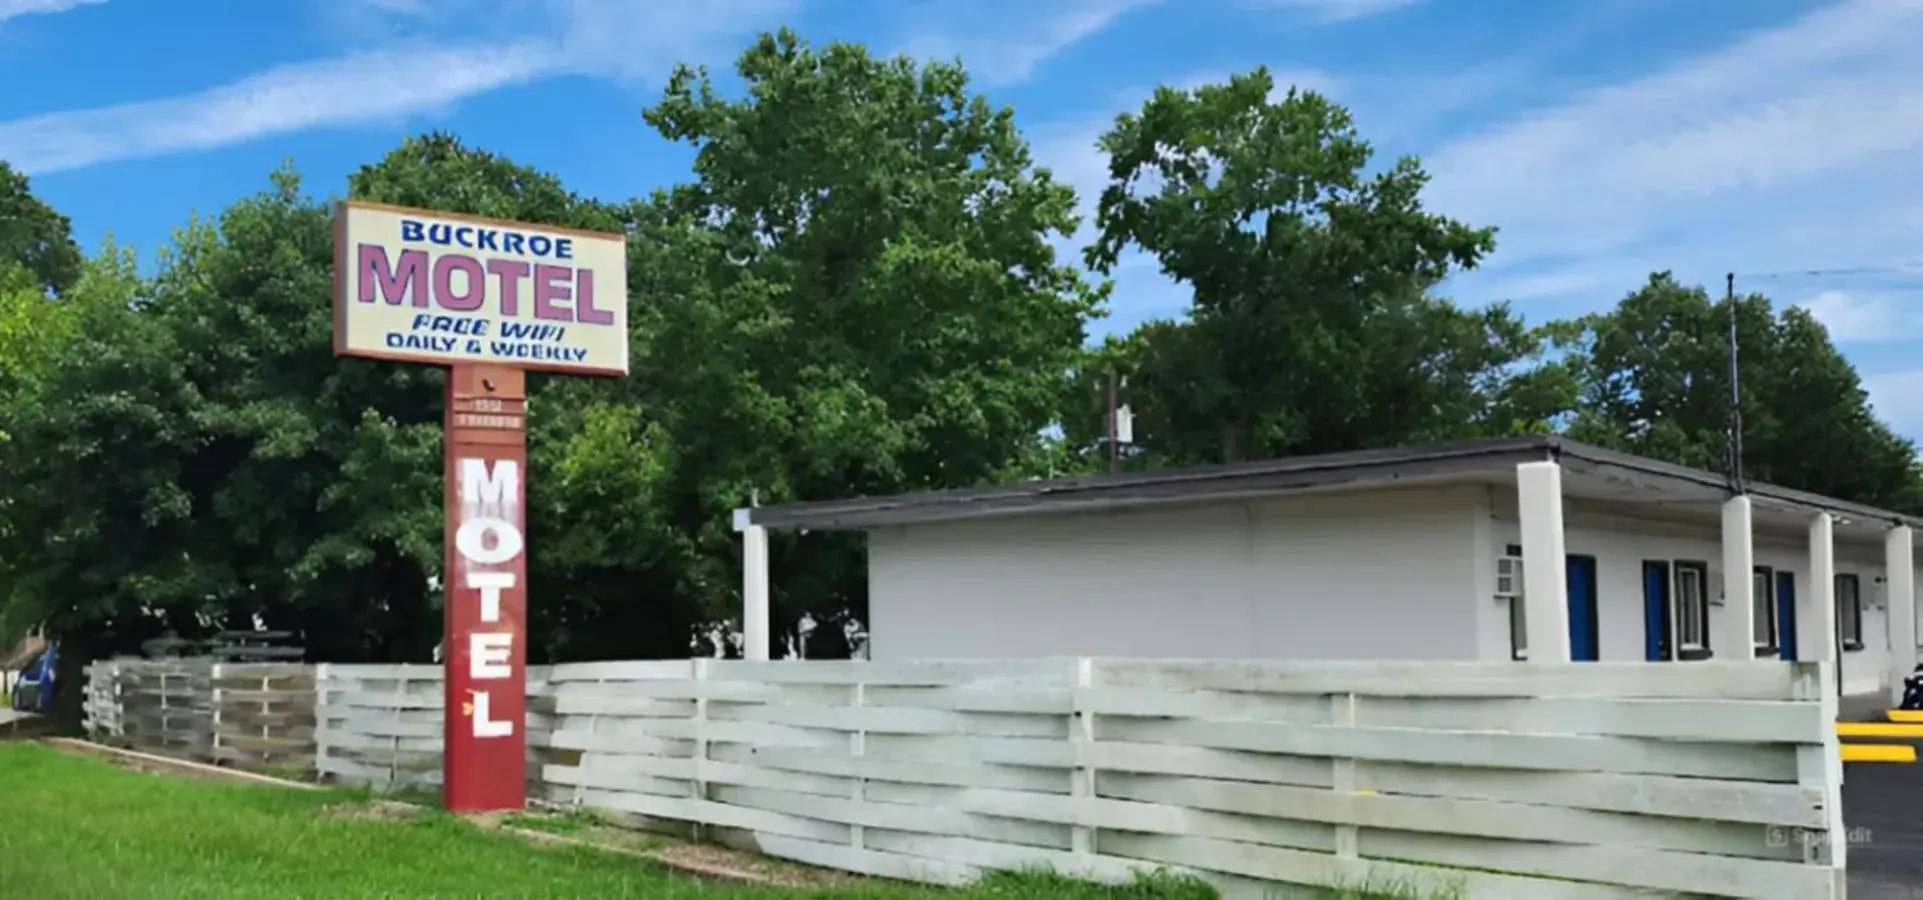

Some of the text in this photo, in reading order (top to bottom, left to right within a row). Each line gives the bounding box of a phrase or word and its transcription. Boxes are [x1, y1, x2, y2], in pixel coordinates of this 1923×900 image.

[401, 220, 573, 258] BUCKROE
[357, 243, 614, 326] MOTEL
[386, 332, 457, 352] DAILY
[456, 458, 523, 738] MOTEL
